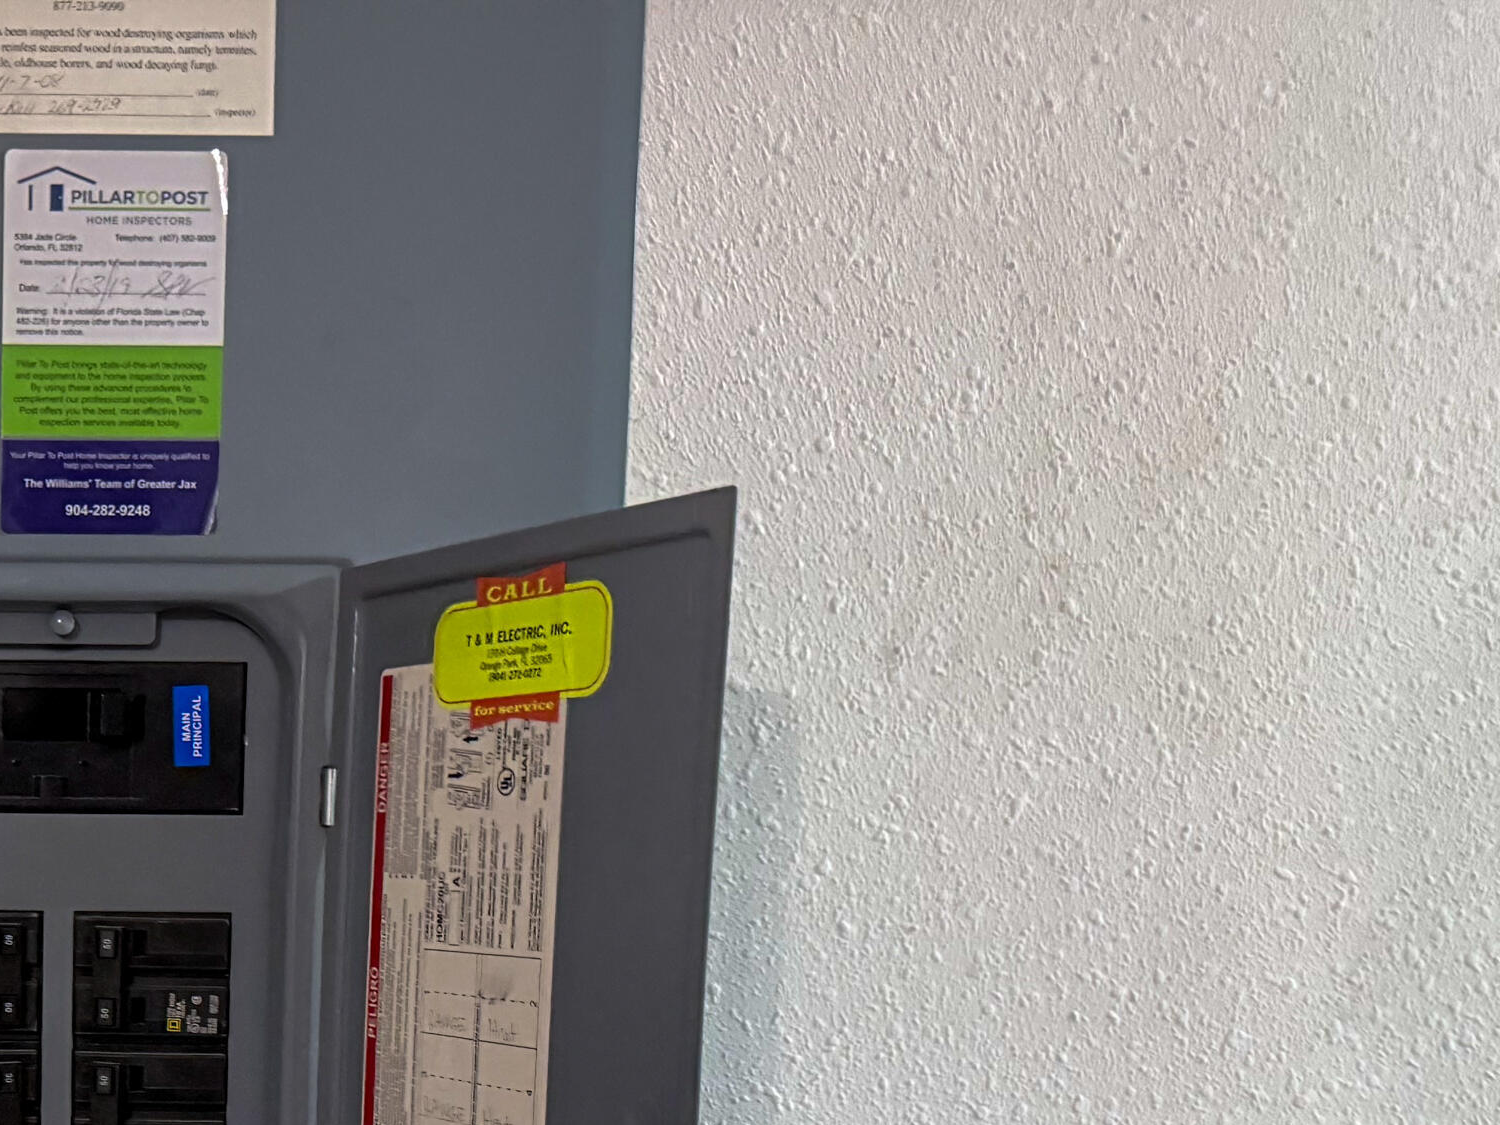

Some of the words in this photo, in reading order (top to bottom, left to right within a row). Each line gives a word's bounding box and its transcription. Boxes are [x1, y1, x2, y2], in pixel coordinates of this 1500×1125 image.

[86, 216, 119, 226] HOME
[122, 216, 192, 226] INSPECTORS
[24, 479, 44, 489] The
[45, 479, 93, 489] Williams'
[94, 479, 123, 489] Team
[124, 479, 136, 489] of
[137, 480, 176, 490] Greater
[178, 480, 198, 490] Jax
[65, 504, 152, 517] 904-282-9248
[485, 577, 553, 603] CALL
[466, 634, 473, 648] T
[475, 634, 482, 647] &
[485, 631, 494, 645] M
[550, 621, 573, 636] INC.
[474, 704, 496, 717] for
[498, 701, 556, 714] service
[182, 712, 191, 743] MAIN
[192, 695, 203, 758] PRINCIPAL
[378, 742, 389, 813] DANGER
[366, 966, 378, 1039] PELIGRO
